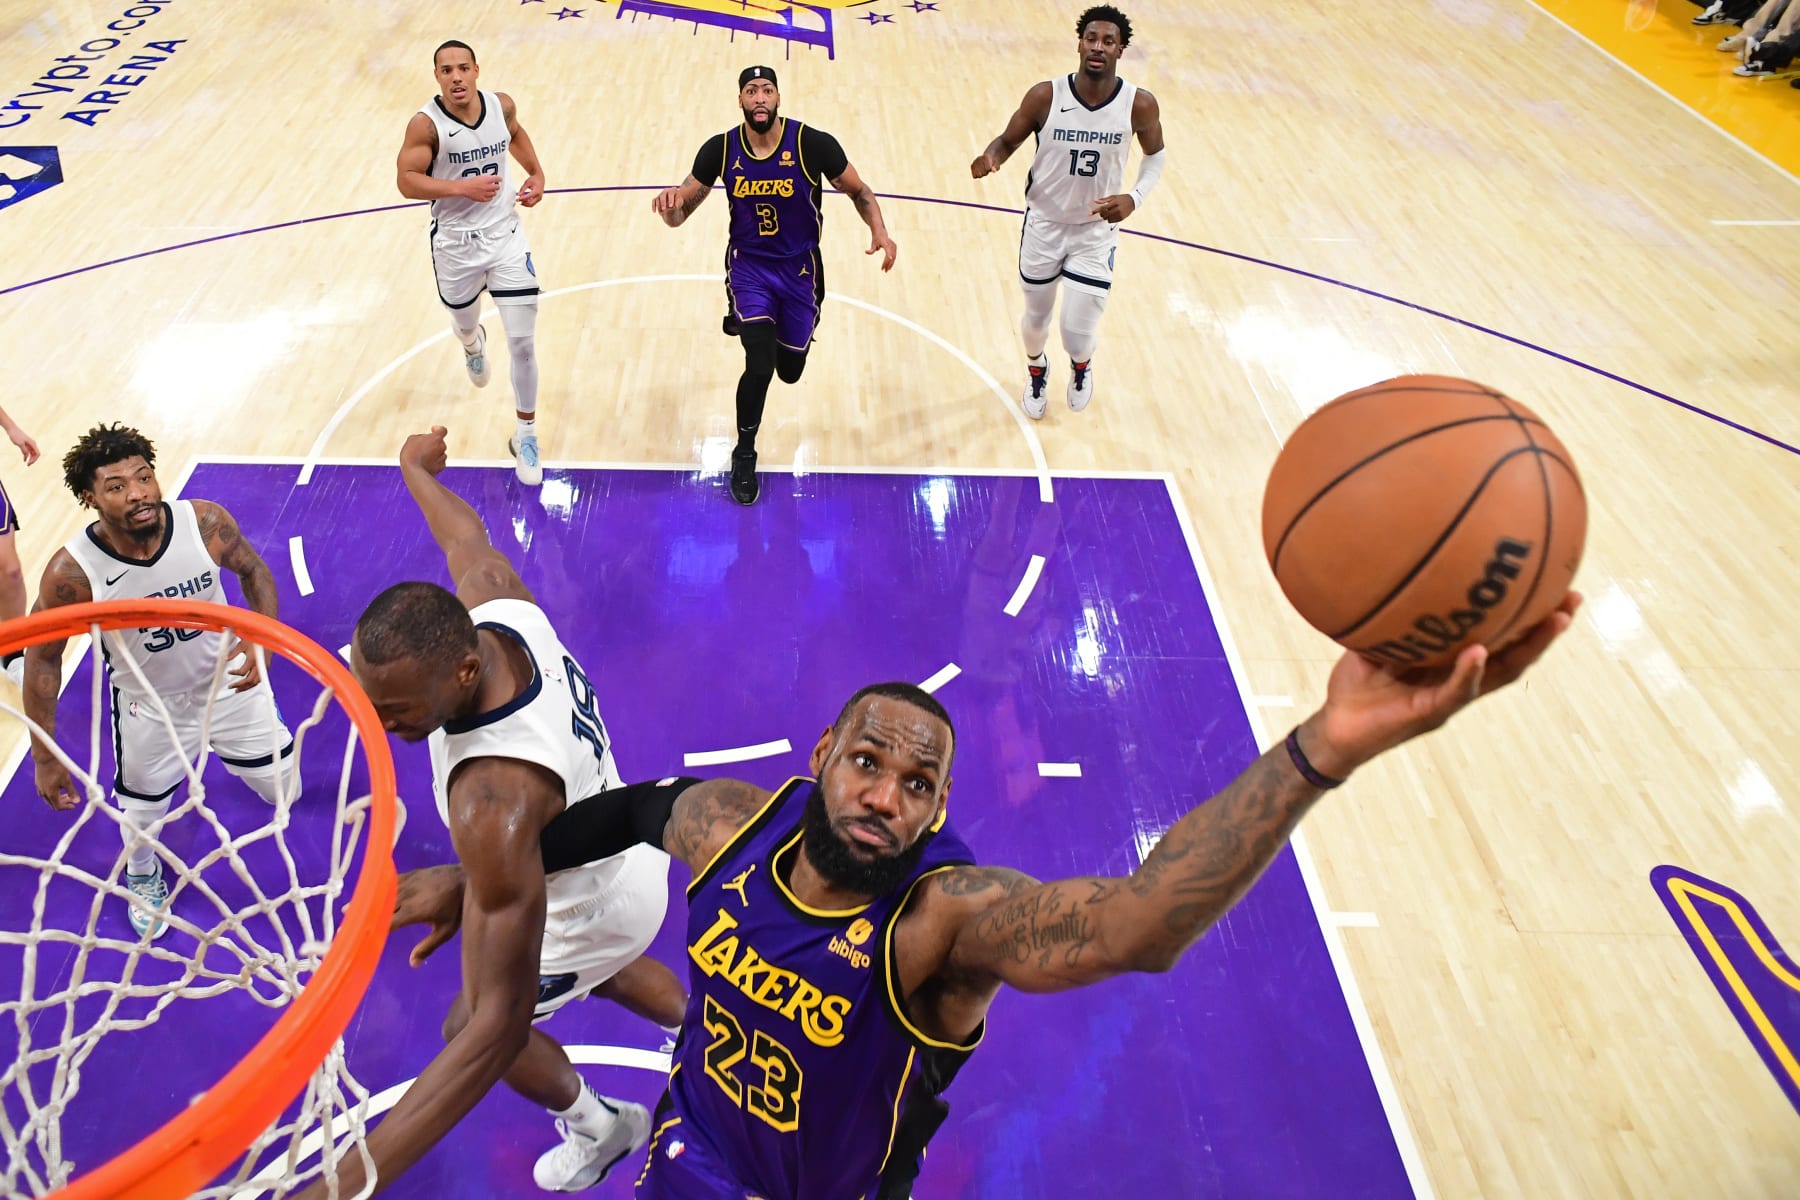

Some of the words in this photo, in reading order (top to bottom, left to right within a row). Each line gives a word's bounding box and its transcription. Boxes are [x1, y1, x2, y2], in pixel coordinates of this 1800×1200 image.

[0, 0, 172, 128] crypto.co
[59, 39, 188, 127] ARENA
[448, 140, 507, 164] MEMPHIS
[1053, 128, 1123, 145] MEMPHIS
[1069, 149, 1101, 177] 13
[732, 175, 795, 198] LAKERS
[756, 203, 779, 236] 3
[827, 935, 871, 970] bibigo
[687, 907, 852, 1048] LAKERS
[703, 993, 803, 1133] 23
